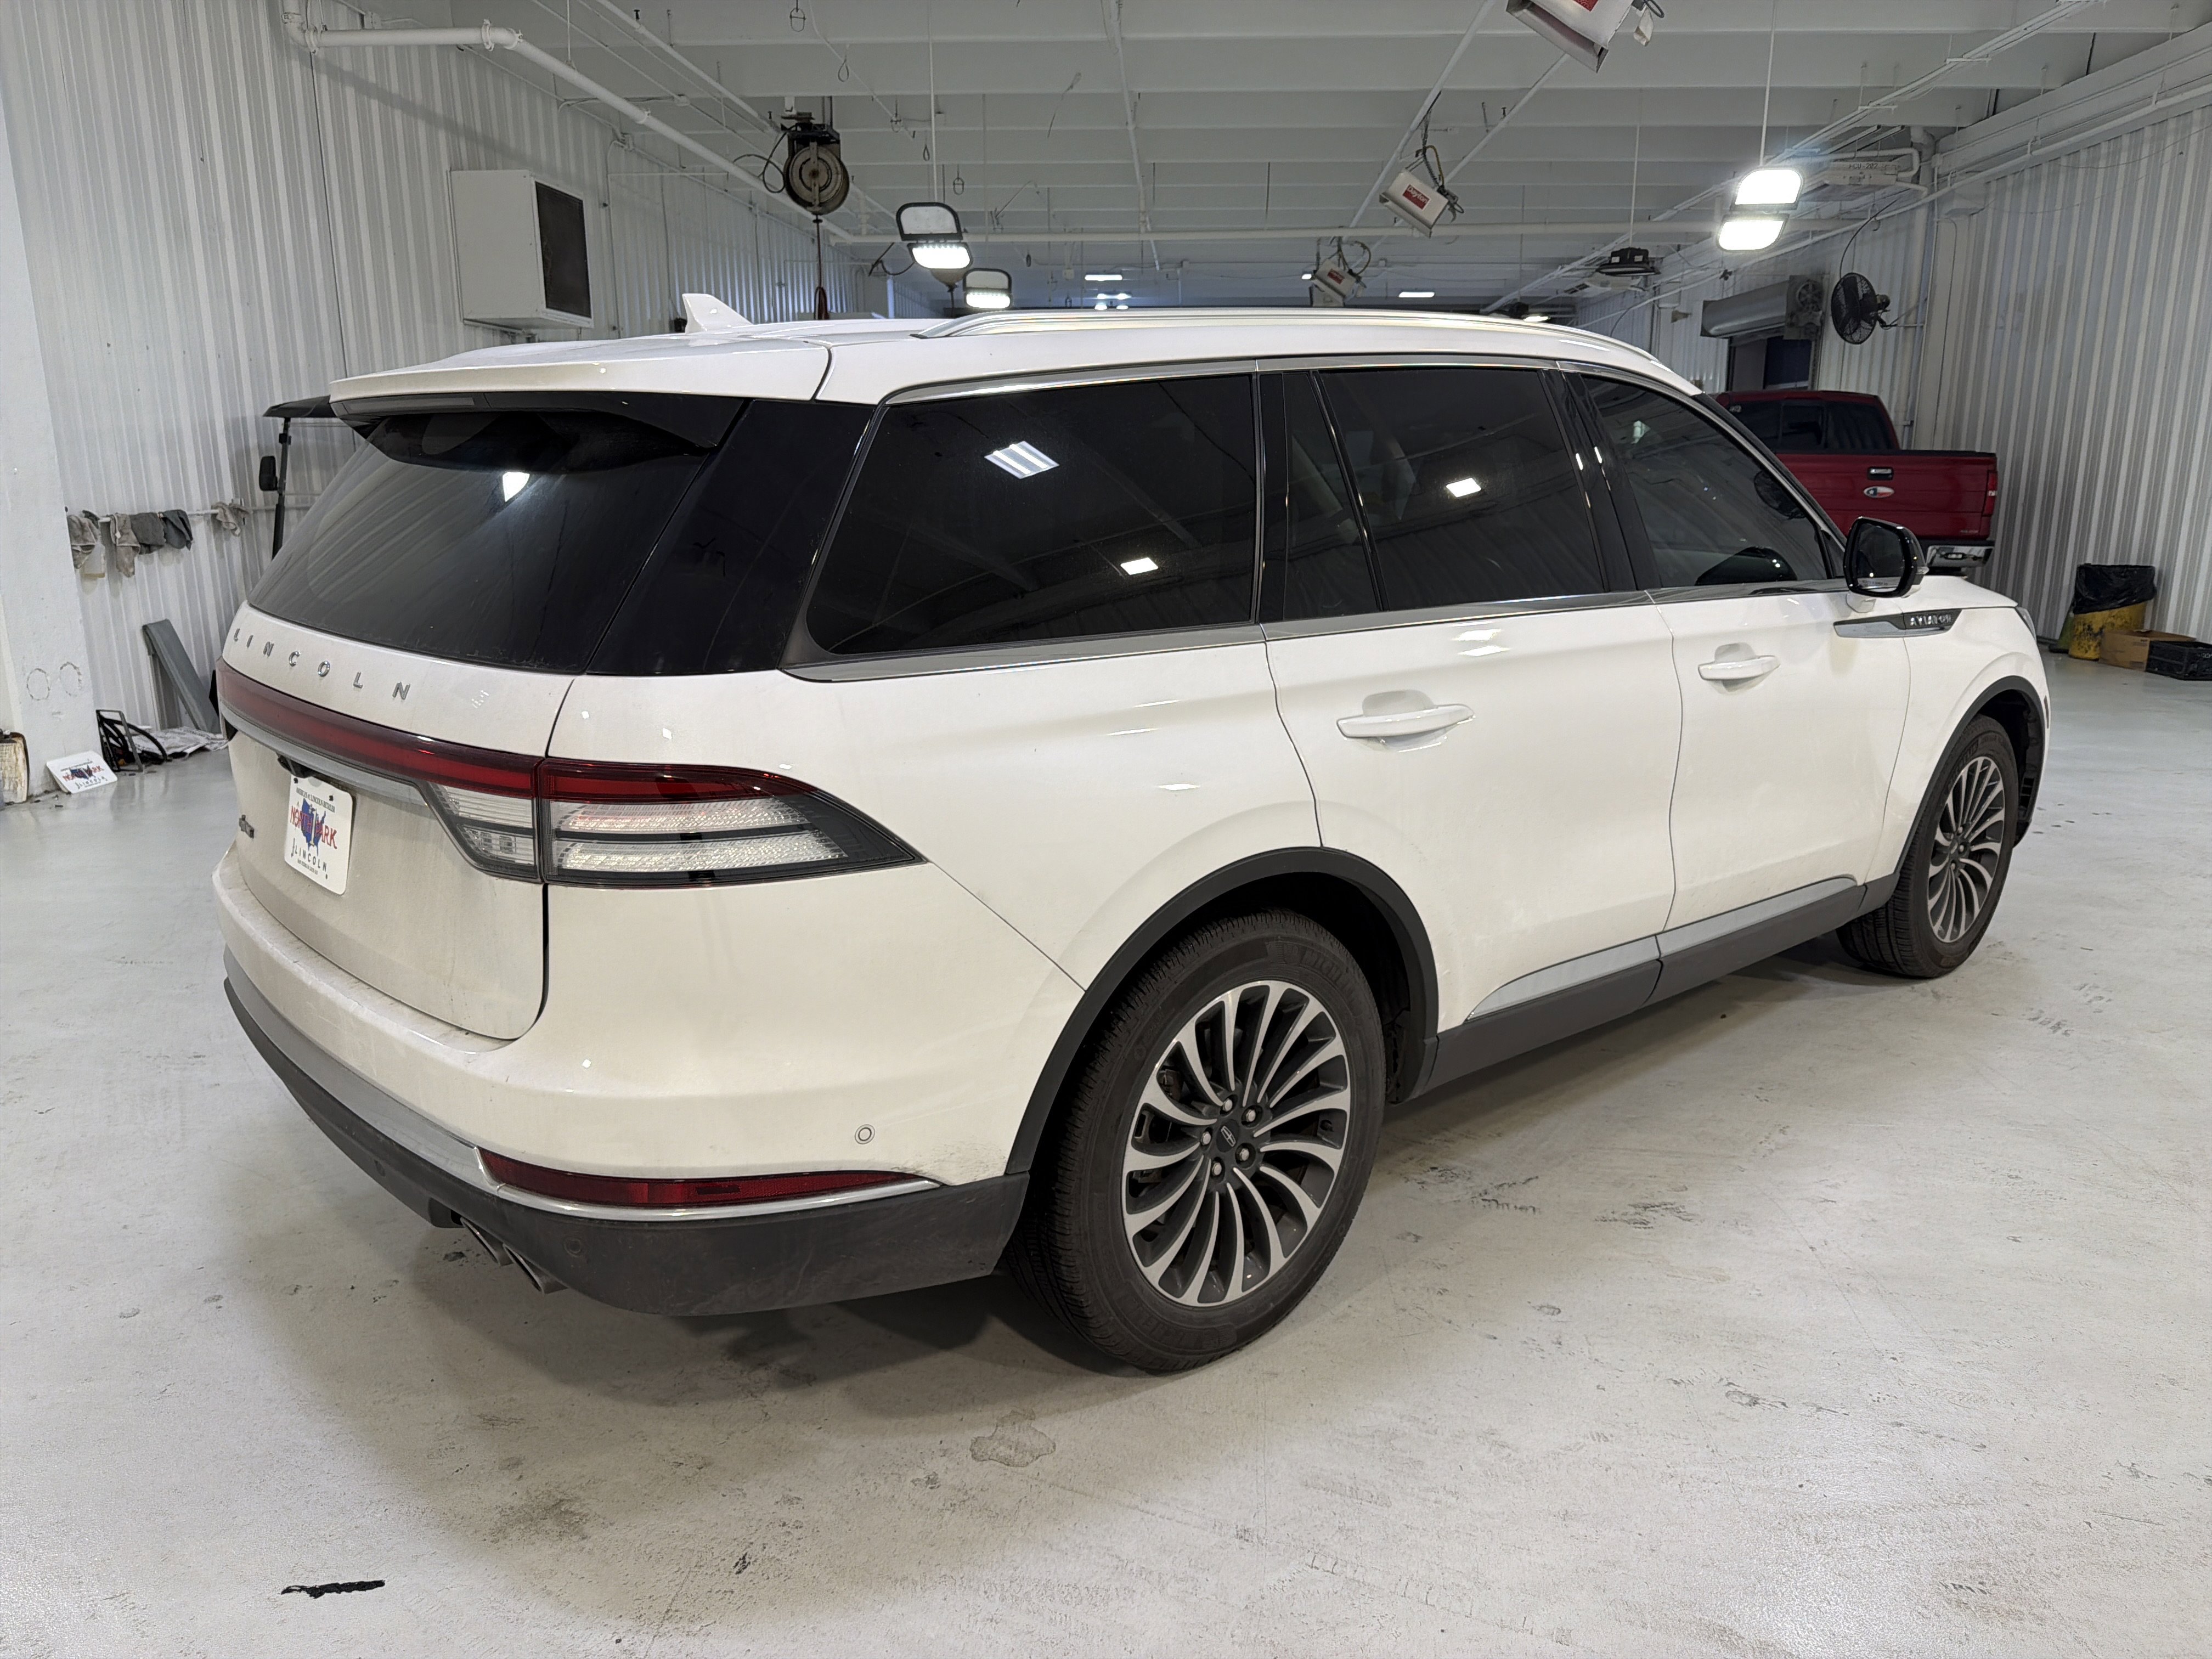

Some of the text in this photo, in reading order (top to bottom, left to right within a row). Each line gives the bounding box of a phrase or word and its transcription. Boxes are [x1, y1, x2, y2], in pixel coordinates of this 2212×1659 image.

[1407, 185, 1428, 204] Dayton
[1910, 614, 1951, 626] AVIATOR
[233, 628, 411, 701] LINCOLN
[290, 805, 312, 834] NORTH
[295, 845, 327, 872] LINCOLN
